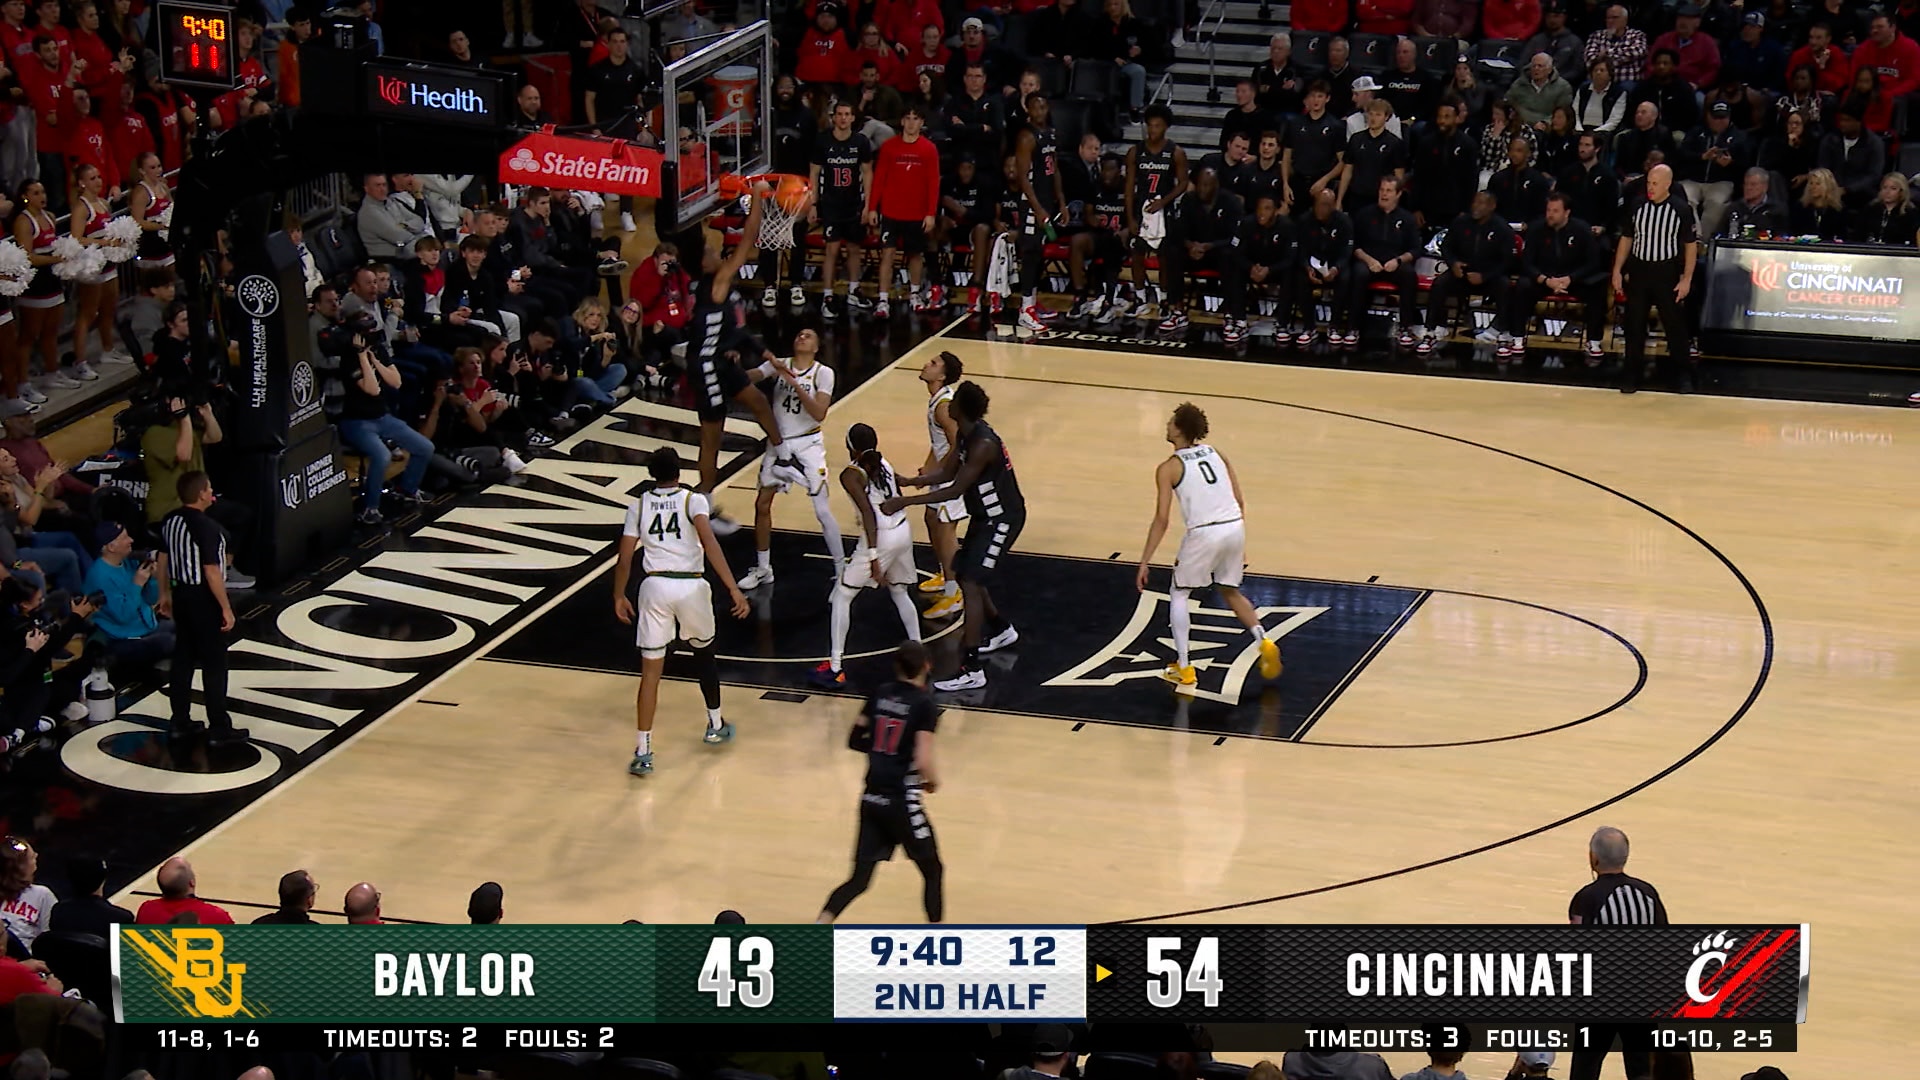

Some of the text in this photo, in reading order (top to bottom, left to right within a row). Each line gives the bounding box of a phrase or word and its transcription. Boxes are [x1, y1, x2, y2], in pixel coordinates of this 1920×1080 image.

[182, 15, 226, 41] 9:40
[191, 42, 219, 70] 11
[727, 89, 744, 109] G
[833, 167, 852, 187] 13
[1148, 173, 1160, 194] 7
[1786, 272, 1903, 294] CINCINNATI
[1787, 291, 1900, 308] CANCER CENTER
[782, 394, 802, 414] 43
[306, 453, 333, 476] LINDNER
[1198, 461, 1218, 485] 0
[308, 465, 335, 487] COLLEGE
[309, 470, 347, 499] OF BUSINESS
[650, 501, 677, 511] POWELL
[648, 512, 681, 541] 44
[61, 398, 767, 794] CINCINNATI
[872, 715, 907, 756] 17
